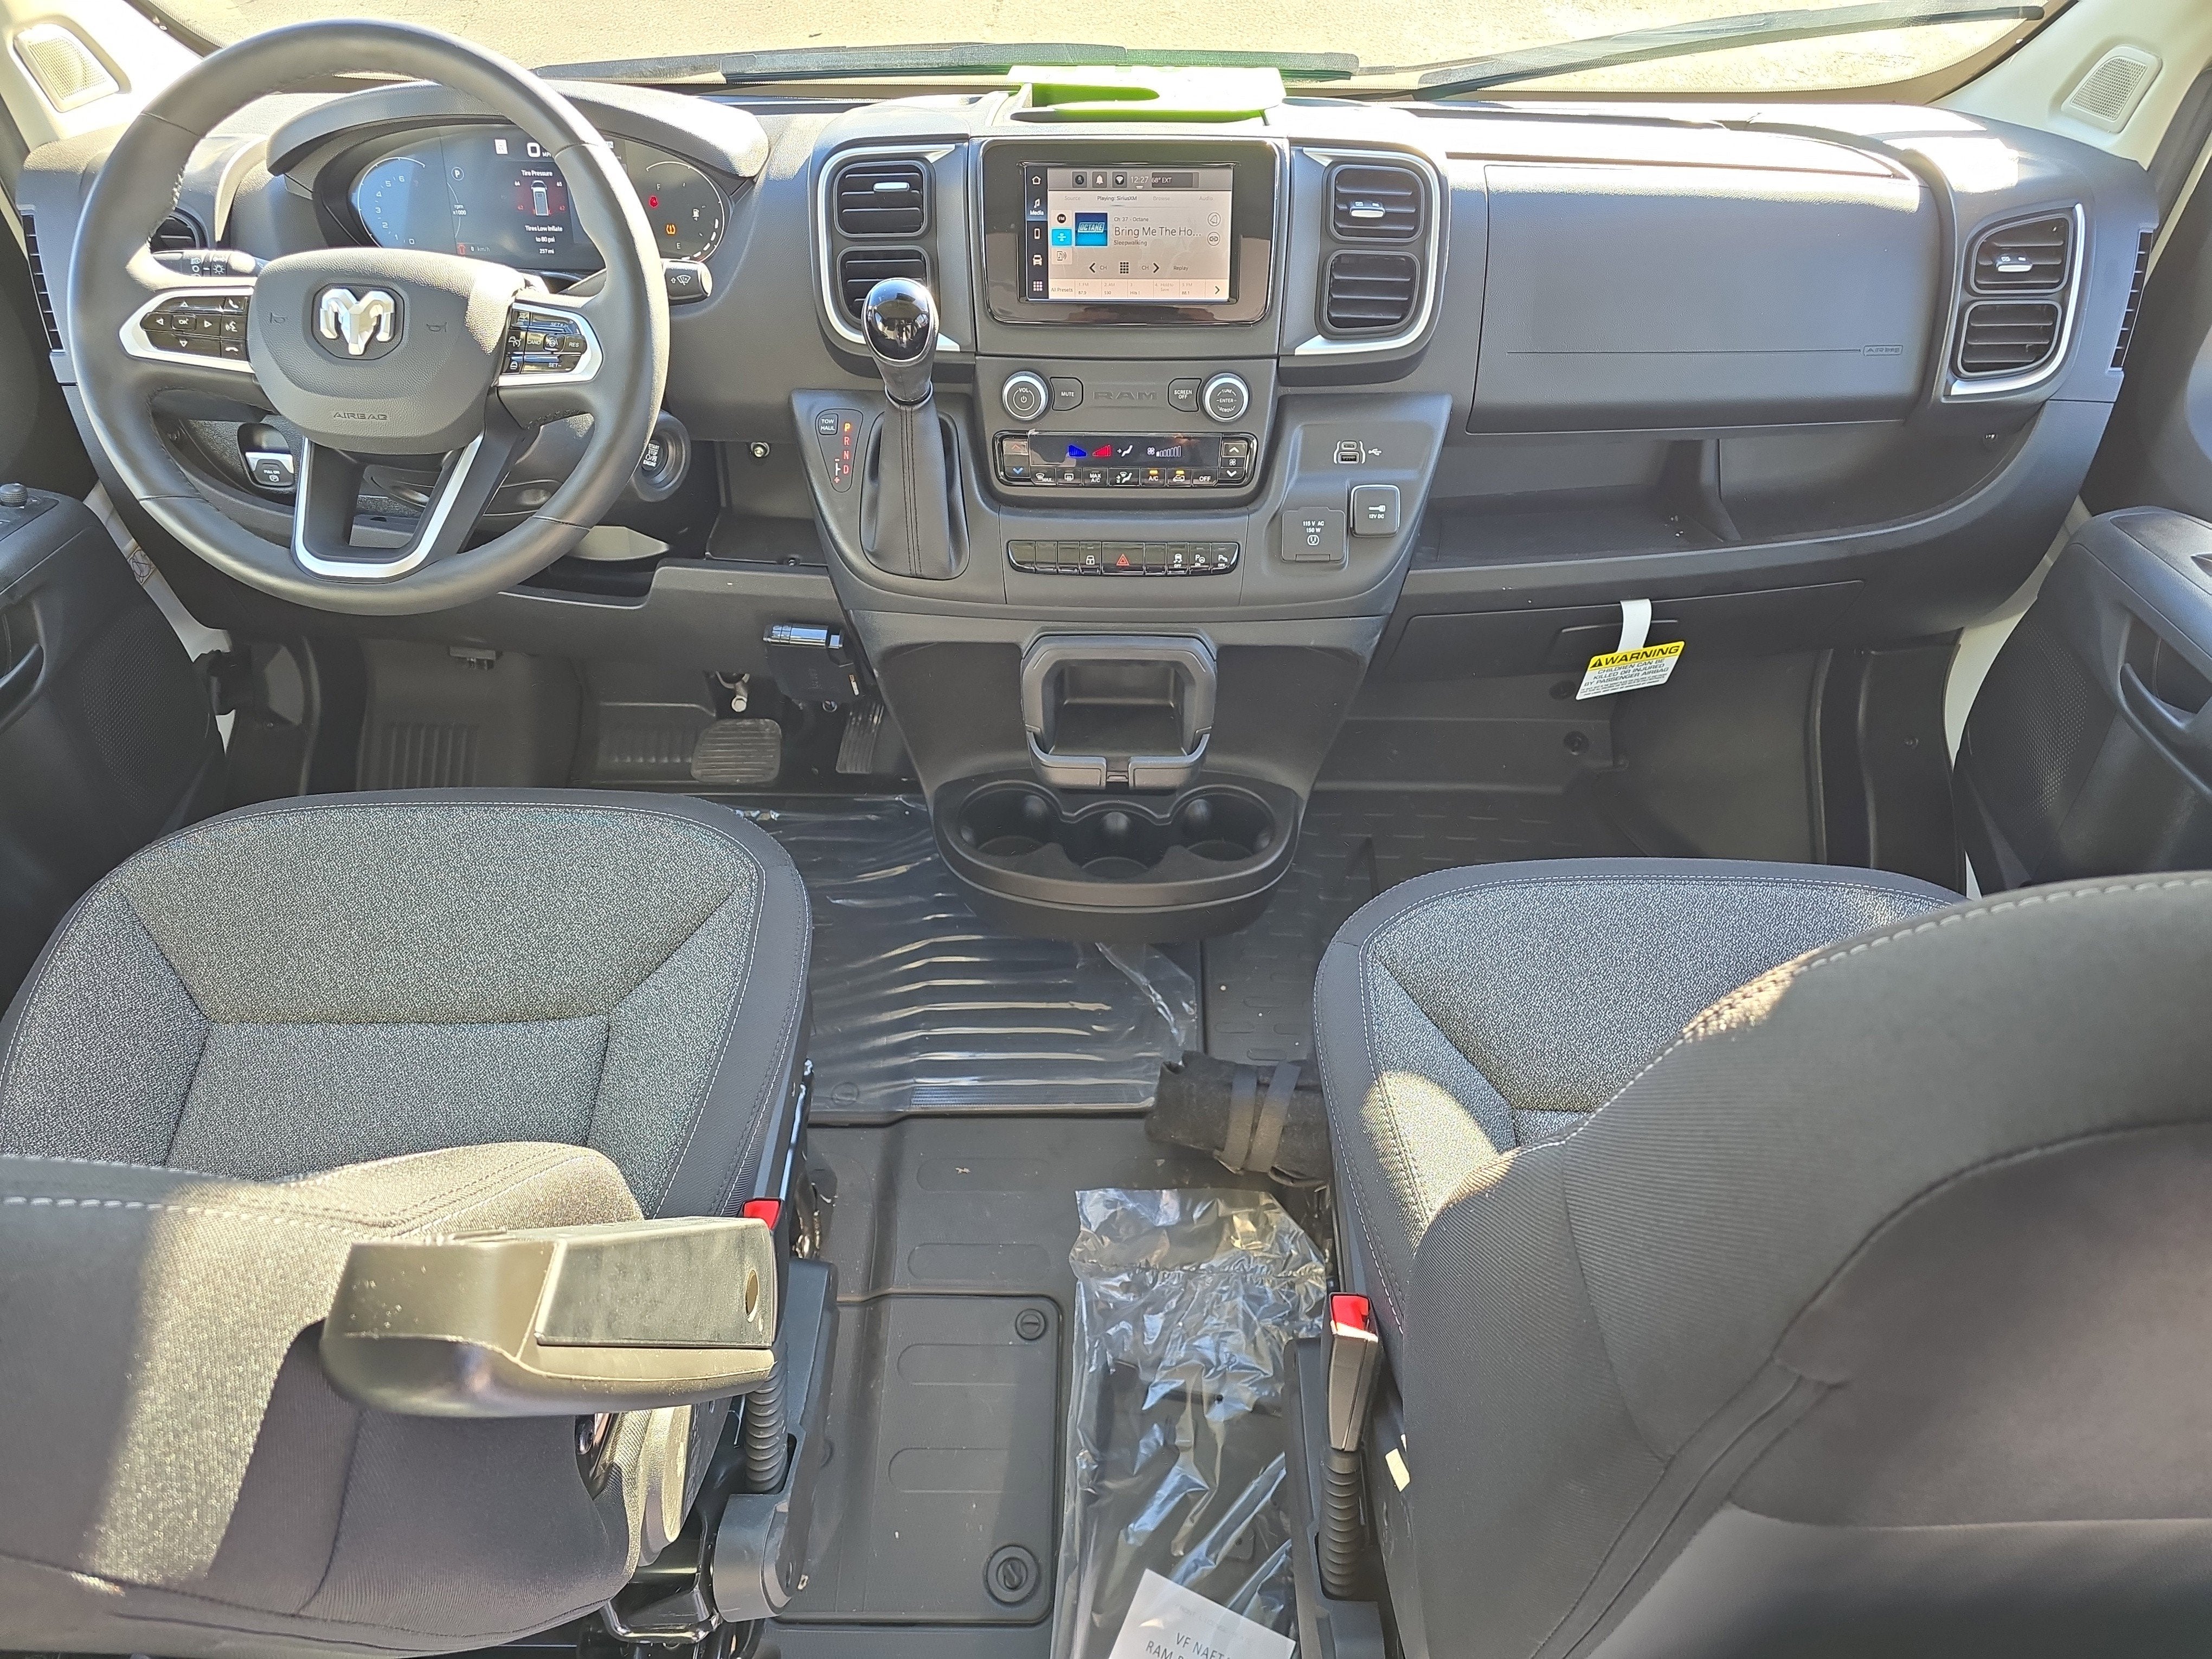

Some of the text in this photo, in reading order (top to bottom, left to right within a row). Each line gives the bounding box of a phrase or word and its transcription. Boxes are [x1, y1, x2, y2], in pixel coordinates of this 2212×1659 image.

[527, 143, 541, 157] 0
[454, 169, 460, 178] P
[1079, 223, 1104, 232] OCTANE
[1114, 227, 1140, 239] Bring
[1142, 227, 1157, 236] Me
[1159, 227, 1176, 236] The
[1092, 391, 1158, 400] RAM
[333, 411, 389, 421] AIRBAG
[845, 423, 851, 432] P
[844, 436, 850, 445] R
[844, 451, 849, 460] N
[843, 465, 849, 474] D
[1605, 645, 1680, 665] WARNING
[1593, 671, 1619, 680] KILLED
[1633, 663, 1665, 673] INJURED
[1598, 663, 1636, 674] CHILDREN
[1596, 673, 1641, 685] PASSENGER
[1642, 667, 1669, 676] AIRBAG
[1146, 1641, 1173, 1659] RAM
[1176, 1632, 1230, 1659] VF NAFT
